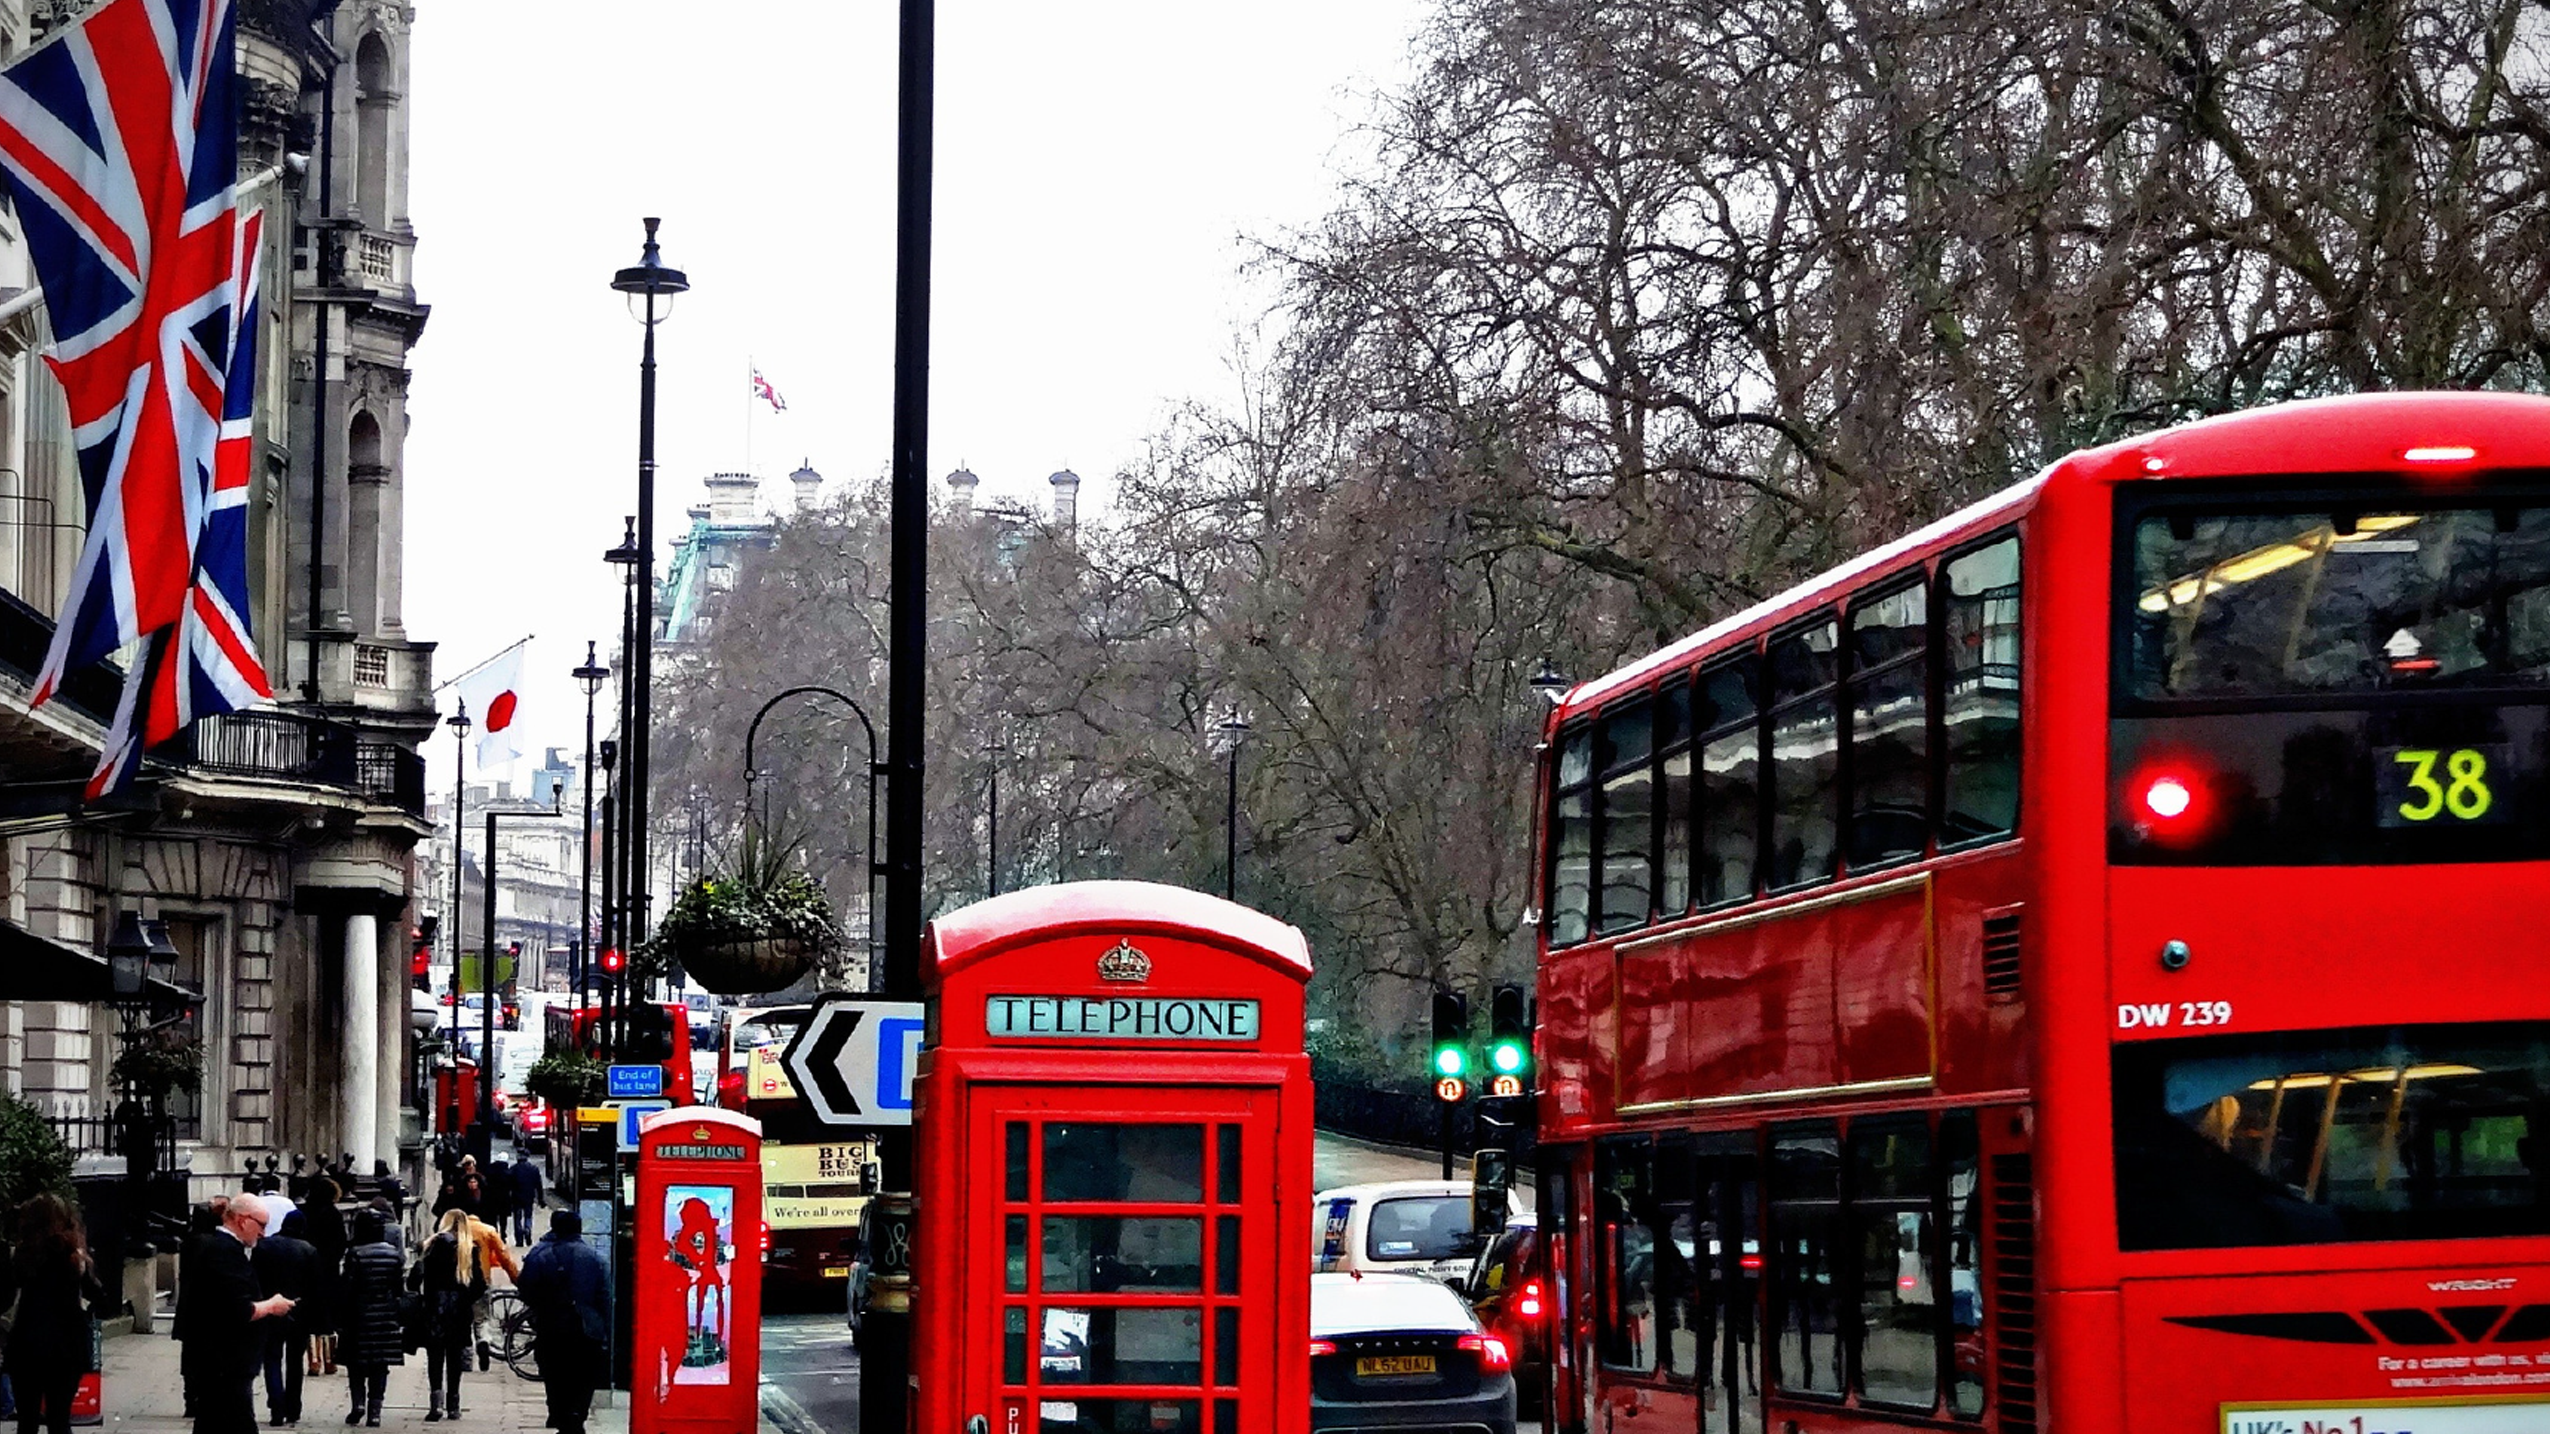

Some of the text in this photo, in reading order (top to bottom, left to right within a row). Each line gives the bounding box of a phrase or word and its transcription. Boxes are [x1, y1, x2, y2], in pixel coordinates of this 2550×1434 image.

[2394, 748, 2493, 821] 38
[998, 999, 1249, 1036] TELEPHONE
[2118, 1001, 2232, 1029] DW 239
[617, 1069, 653, 1080] End of
[613, 1081, 657, 1090] bus lane
[660, 1145, 742, 1159] TELEPHONE
[819, 1146, 863, 1159] BIG
[819, 1158, 862, 1170] BUS
[774, 1206, 860, 1218] We're all over
[2378, 1356, 2405, 1371] For
[2406, 1358, 2419, 1370] a
[2473, 1353, 2507, 1367] with
